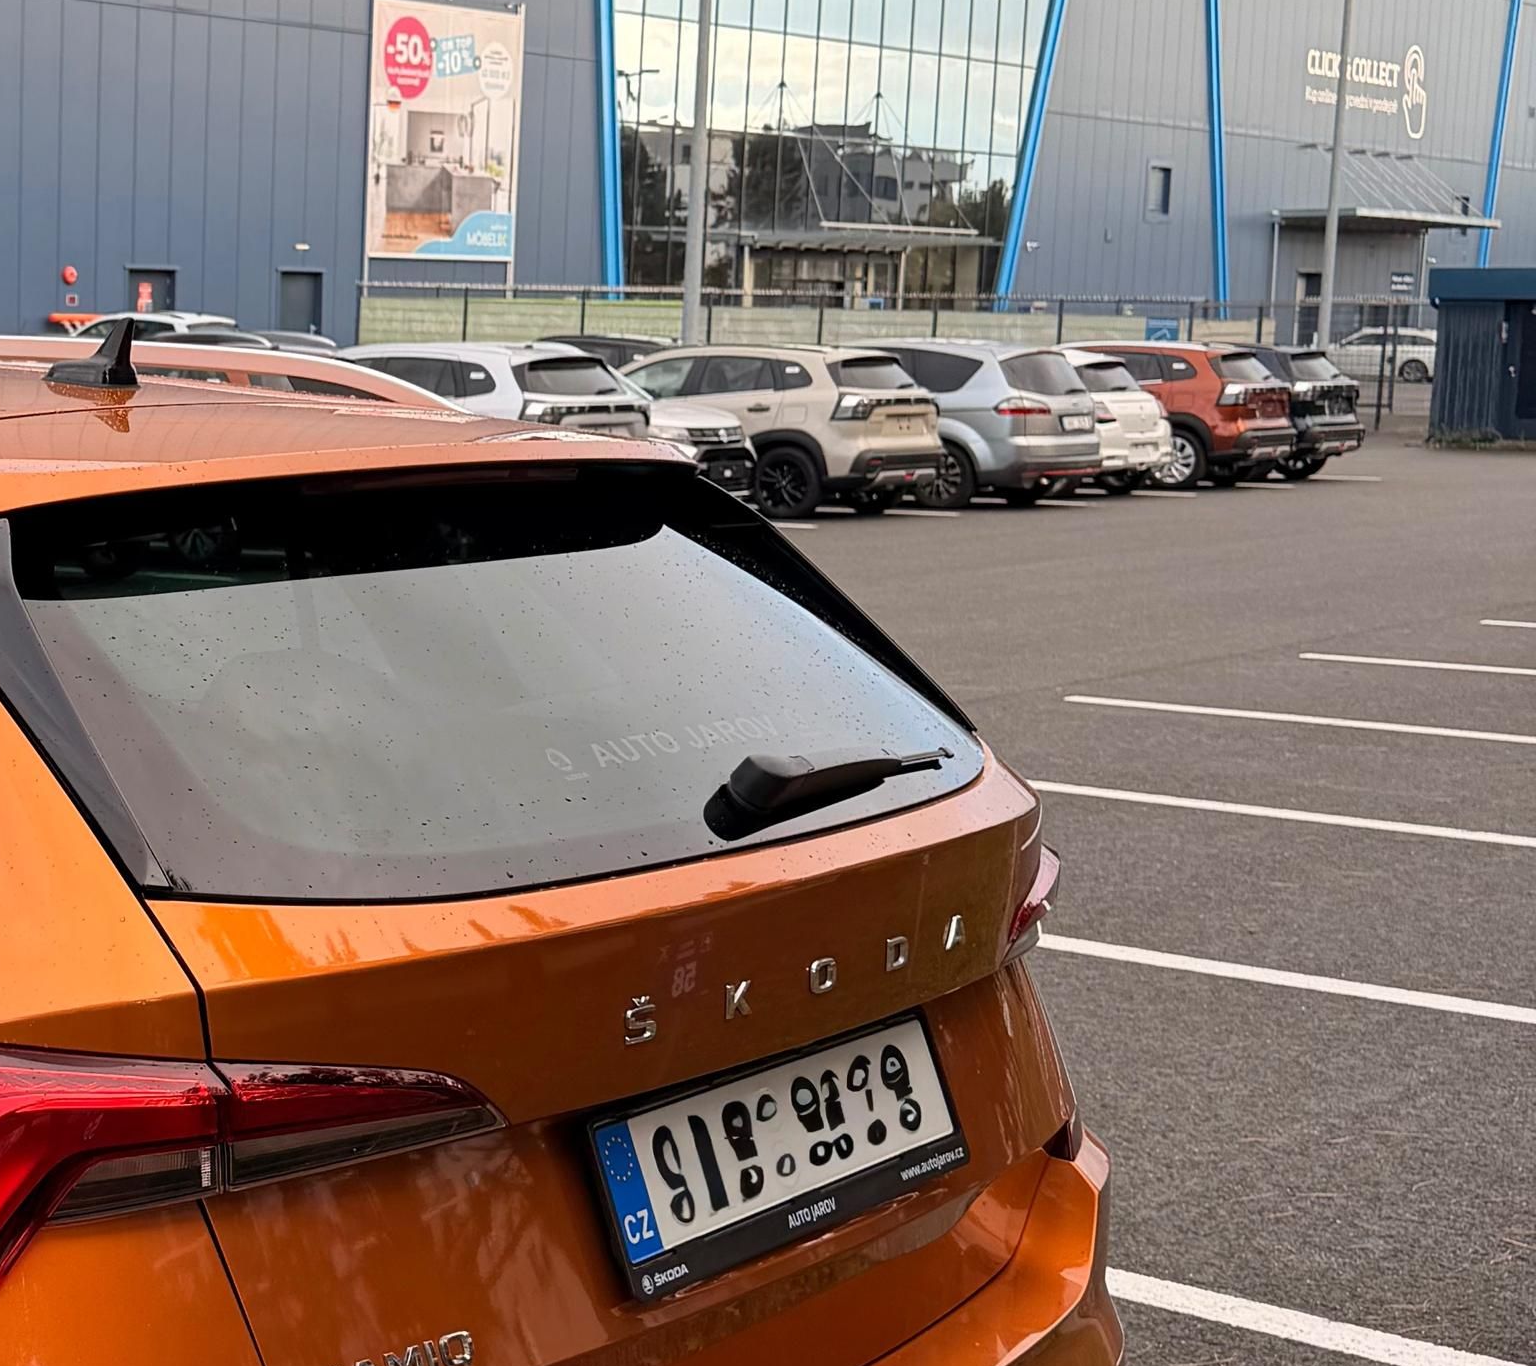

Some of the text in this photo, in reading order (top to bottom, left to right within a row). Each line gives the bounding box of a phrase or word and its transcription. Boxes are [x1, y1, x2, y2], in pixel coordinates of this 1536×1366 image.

[1307, 48, 1342, 79] CLICK
[1351, 56, 1401, 88] COLLECT
[591, 713, 779, 768] AUTO JAROV
[624, 914, 966, 1046] ŠKODA
[899, 1146, 965, 1181] www.autojarov.cz
[623, 1208, 655, 1245] CZ
[788, 1196, 837, 1230] AUTO JAROV
[653, 1262, 690, 1287] ŠKODA
